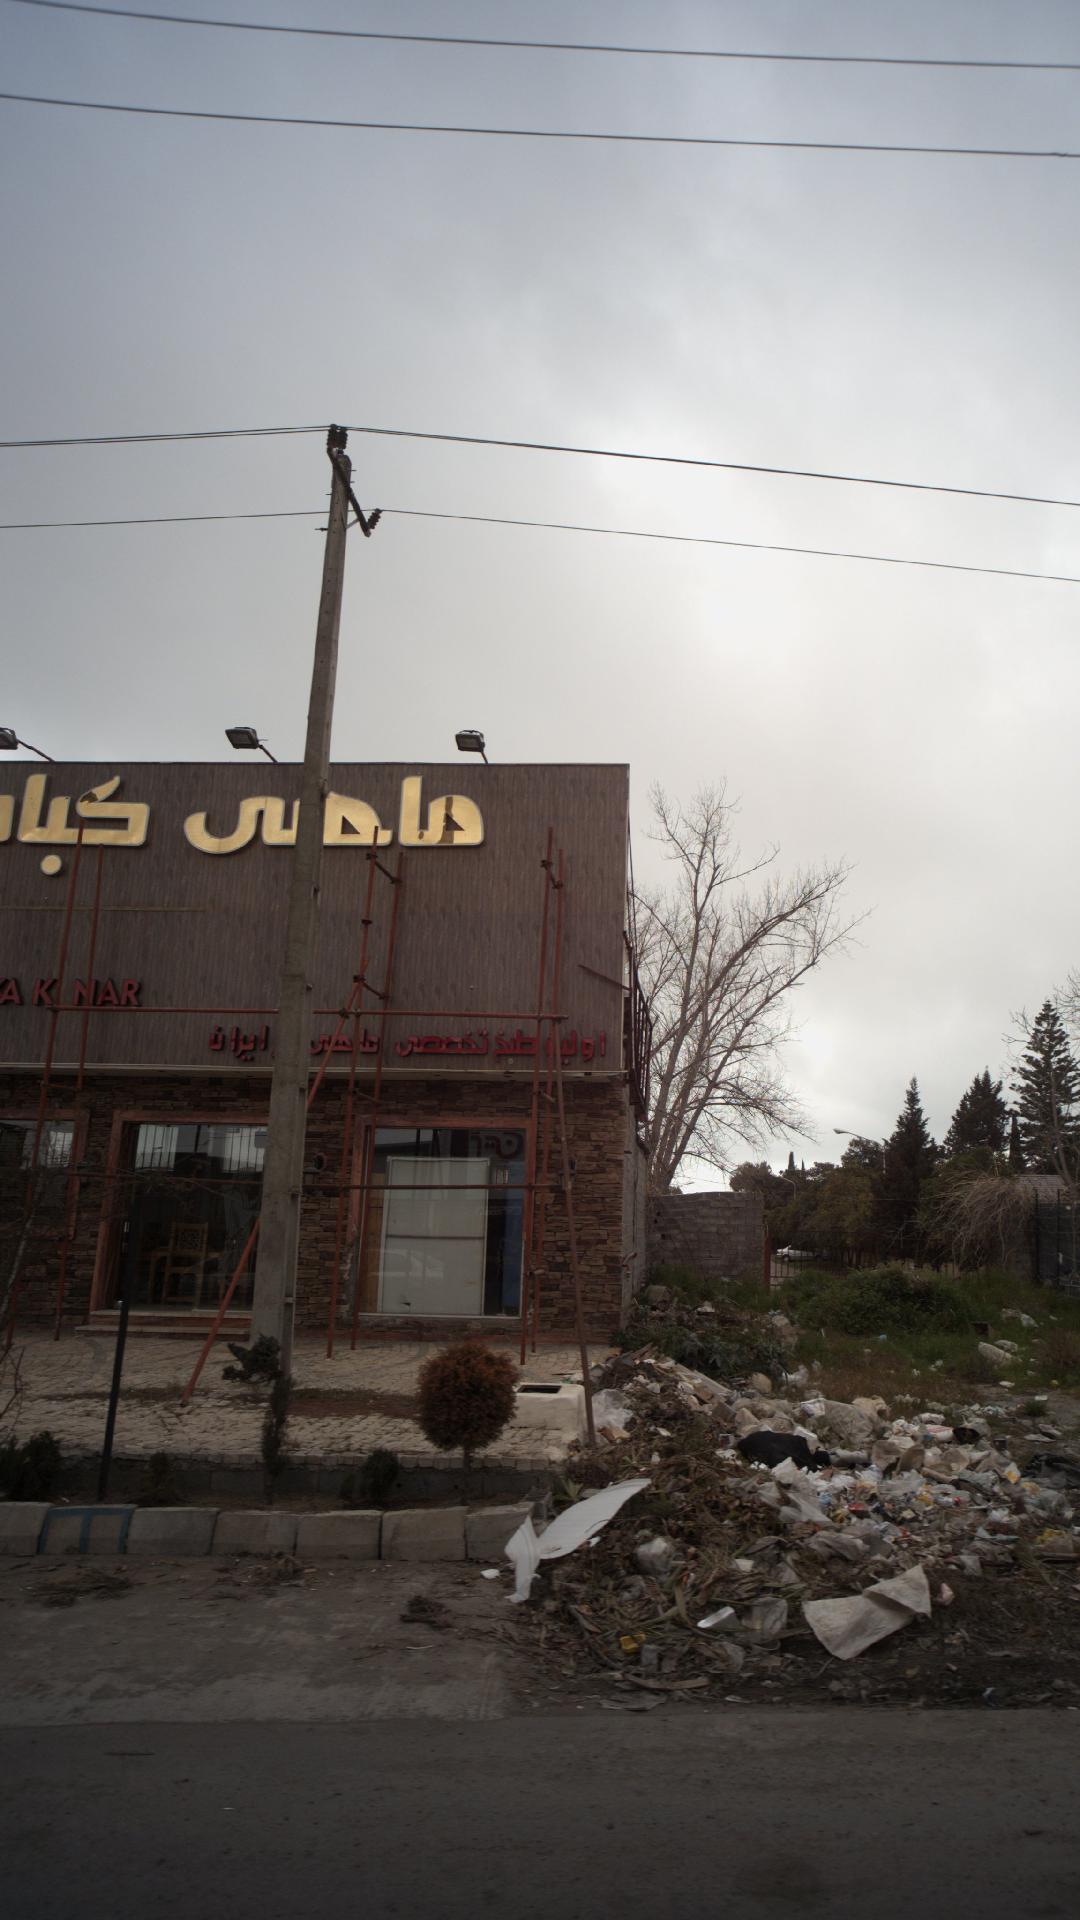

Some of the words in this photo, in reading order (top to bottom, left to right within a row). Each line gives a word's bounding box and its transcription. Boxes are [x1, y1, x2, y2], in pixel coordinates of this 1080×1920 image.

[0, 774, 151, 876] کبا
[183, 774, 485, 854] ماهی
[72, 979, 142, 1008] NAR
[208, 1024, 270, 1062] ایران
[310, 1030, 381, 1056] ماهی
[395, 1029, 490, 1057] تخصصی
